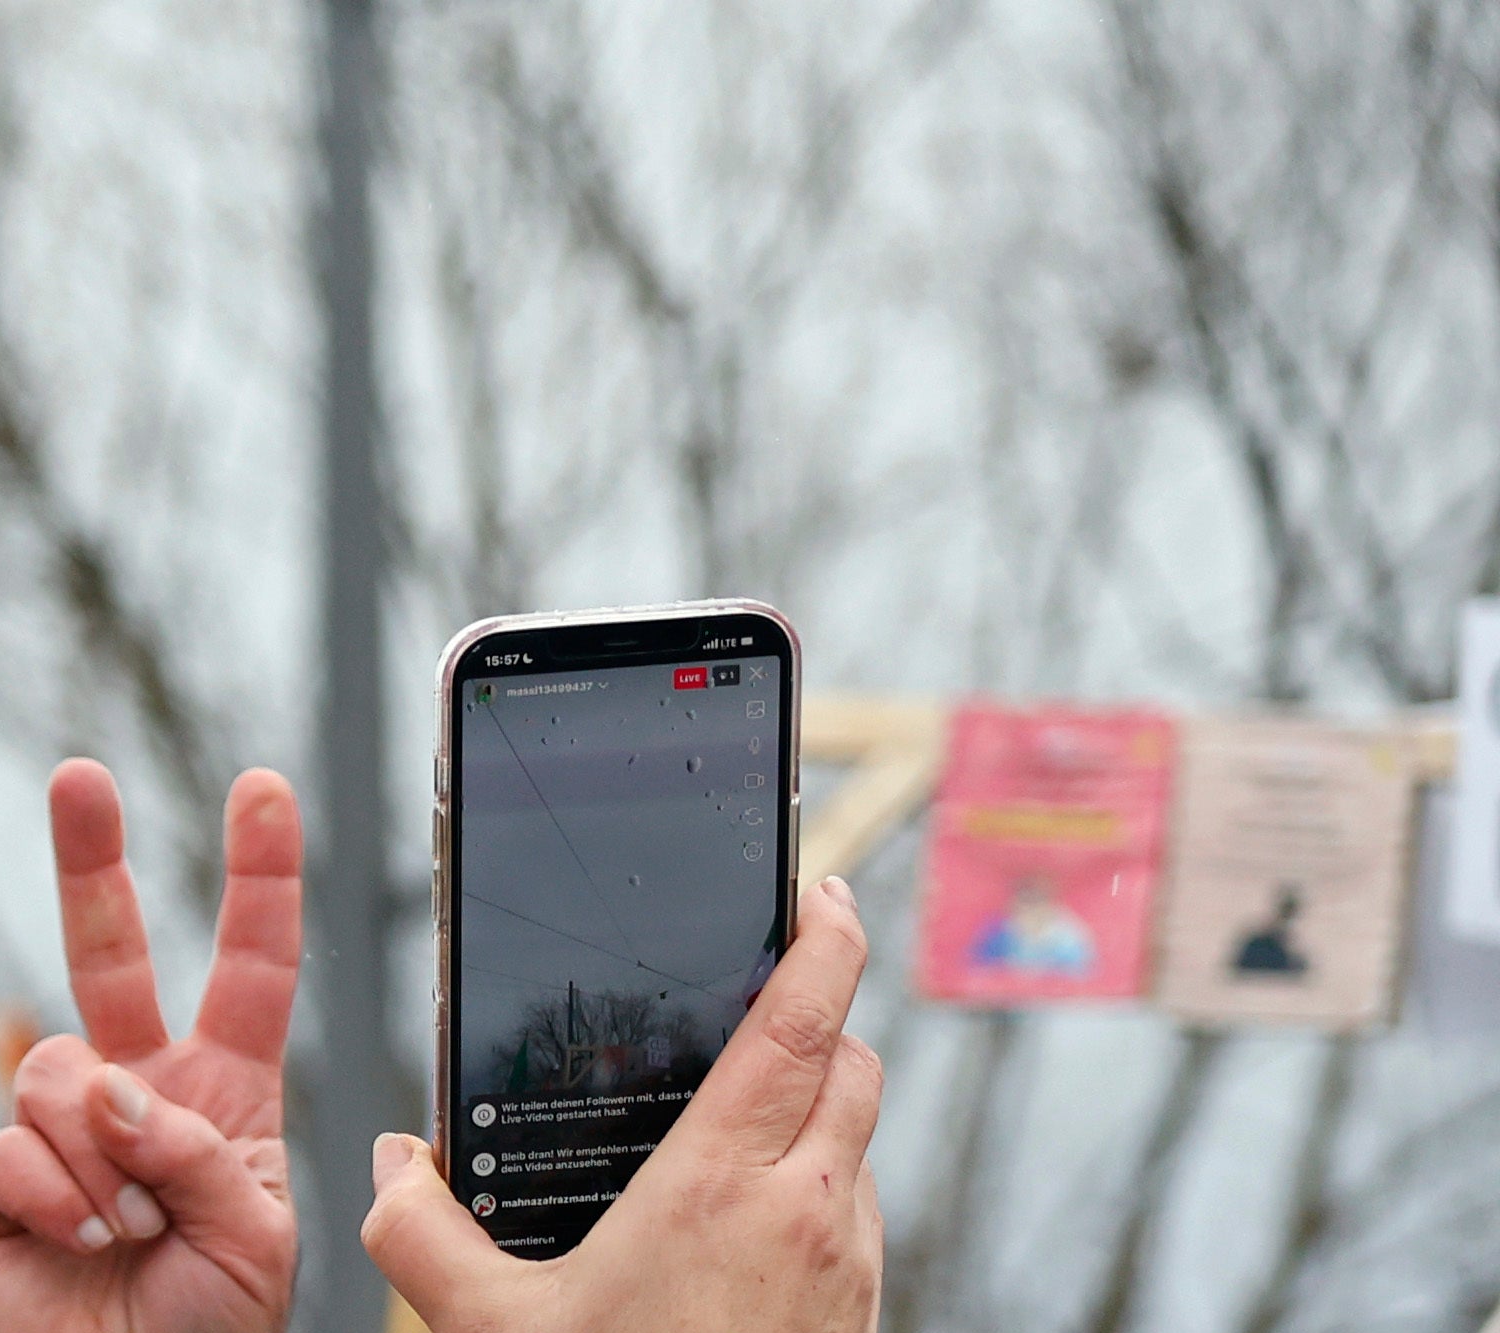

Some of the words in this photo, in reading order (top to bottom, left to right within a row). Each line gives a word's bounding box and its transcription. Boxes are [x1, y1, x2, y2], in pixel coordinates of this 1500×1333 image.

[720, 638, 737, 649] LTE
[485, 653, 520, 667] 15:57
[679, 674, 701, 683] LIVE
[501, 1102, 519, 1112] Wir
[521, 1101, 548, 1111] teilen
[550, 1099, 584, 1109] deinen
[586, 1095, 635, 1106] Followern
[636, 1092, 655, 1103] mit,
[658, 1091, 682, 1101] dass
[501, 1112, 554, 1124] Live-Video
[556, 1110, 601, 1122] gestartet
[604, 1107, 628, 1116] hast.
[501, 1151, 526, 1161] Bleib
[528, 1149, 554, 1160] dran!
[557, 1148, 574, 1158] Wir
[576, 1145, 628, 1157] empfehlen
[501, 1163, 523, 1173] dein
[525, 1162, 554, 1172] Video
[555, 1158, 612, 1170] anzusehen.
[501, 1192, 599, 1208] mahnazafrazmand
